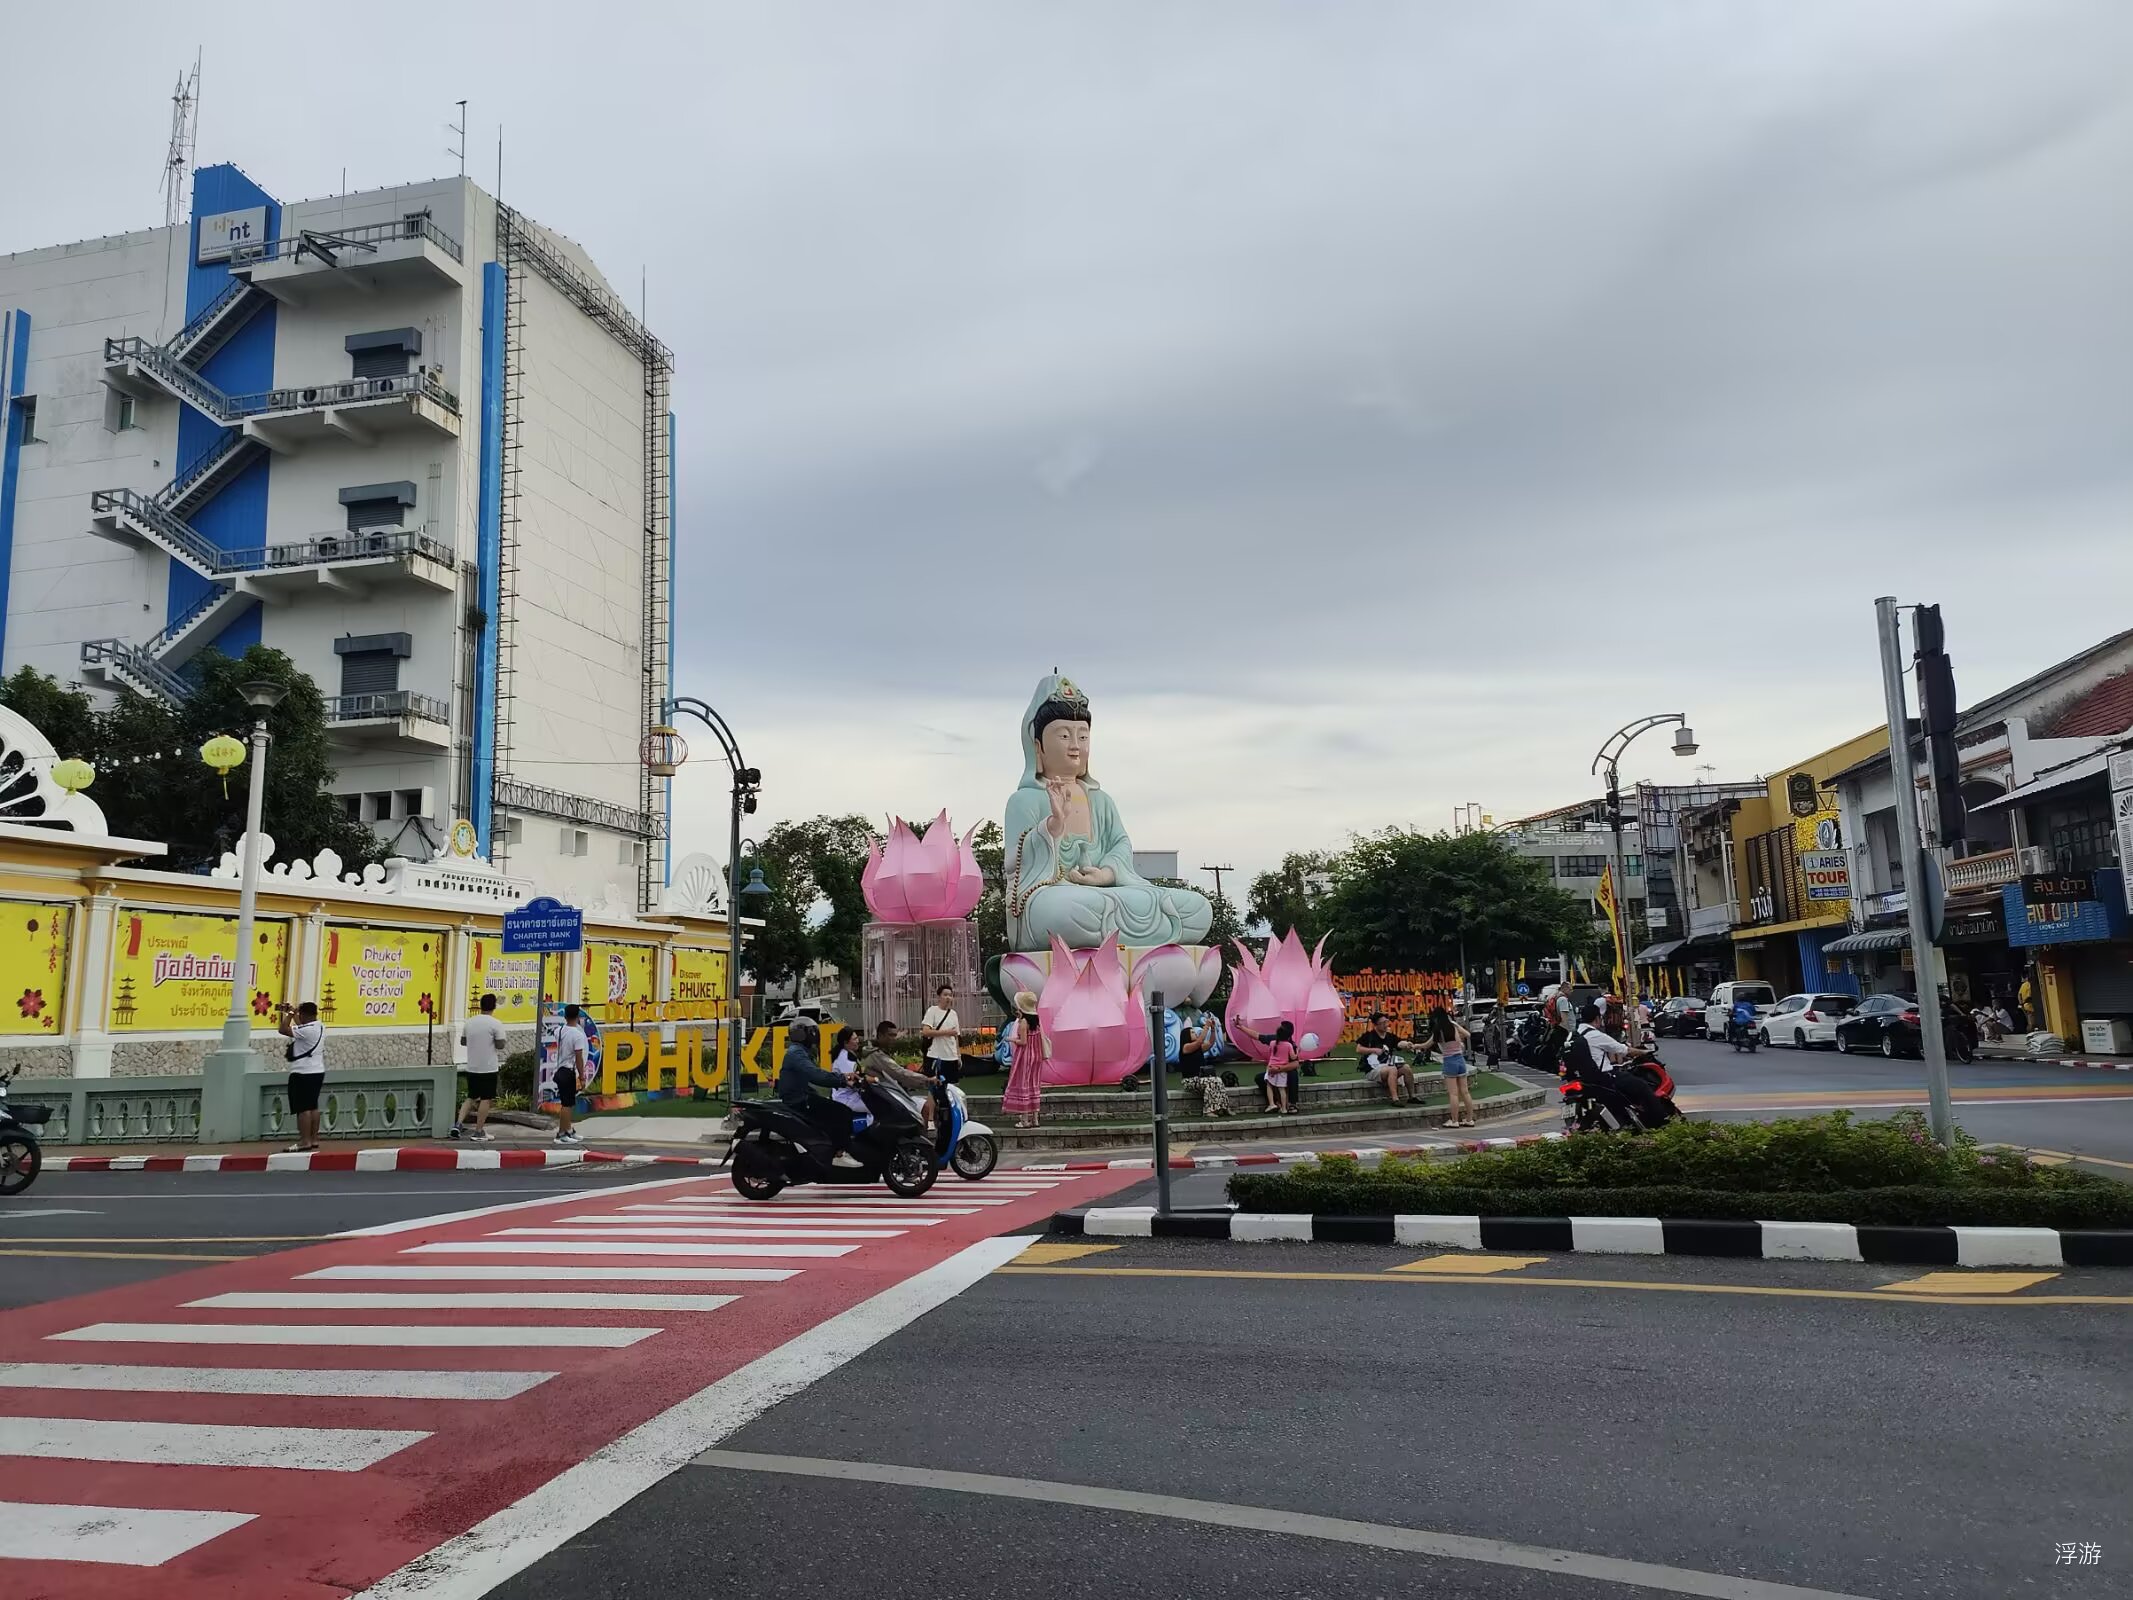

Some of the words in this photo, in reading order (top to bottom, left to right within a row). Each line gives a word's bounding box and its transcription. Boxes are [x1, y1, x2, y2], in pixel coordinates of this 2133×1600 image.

[230, 221, 250, 240] nt
[1820, 856, 1846, 869] ARIES
[1808, 870, 1848, 885] TOUR
[507, 914, 579, 929] ธนาคารชาร์เตอร์
[148, 936, 189, 948] ประเพณี
[513, 932, 548, 940] CHARTER
[364, 947, 402, 961] Phuket
[352, 965, 412, 982] Vegetarian
[680, 969, 702, 979] Discover
[359, 983, 403, 996] Festival
[680, 982, 717, 998] PHUKET
[171, 1003, 209, 1016] ประจำปี
[365, 1002, 396, 1015] 2024
